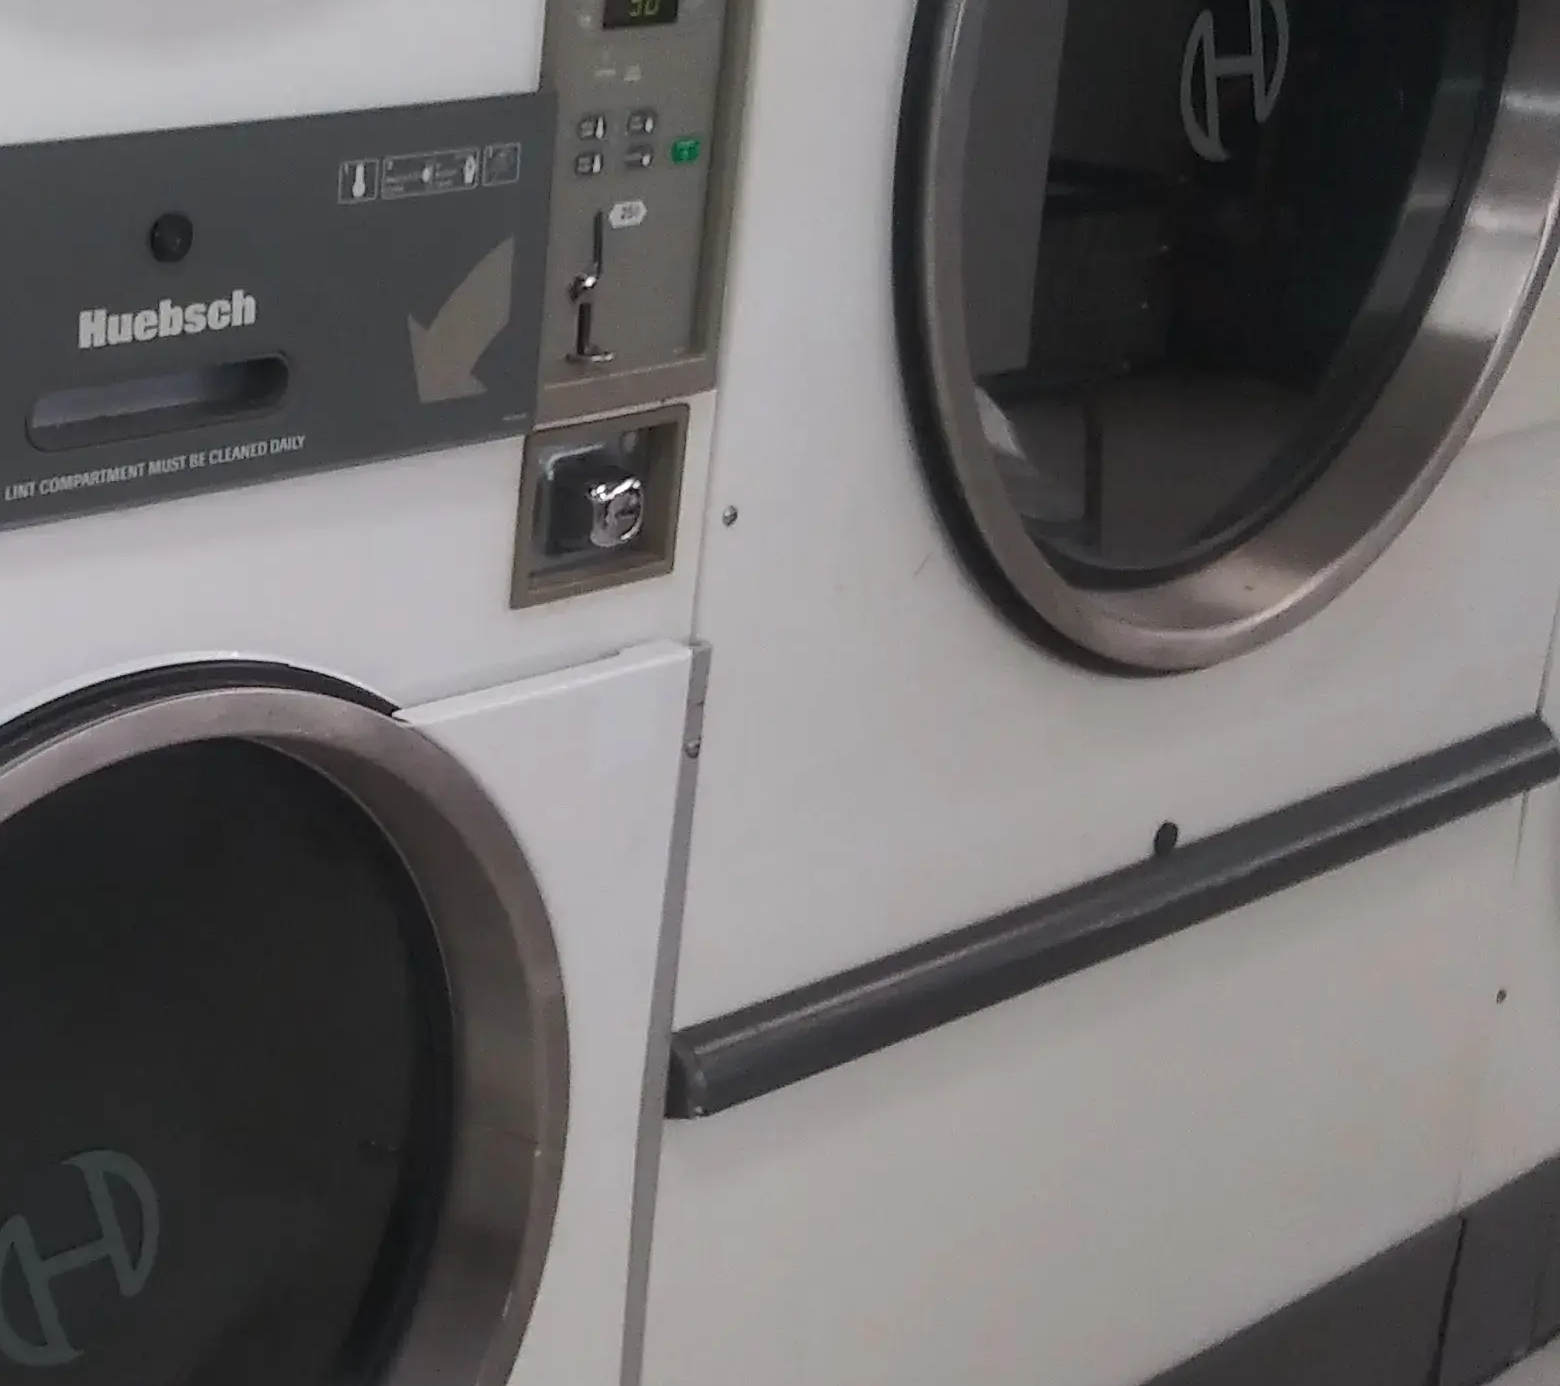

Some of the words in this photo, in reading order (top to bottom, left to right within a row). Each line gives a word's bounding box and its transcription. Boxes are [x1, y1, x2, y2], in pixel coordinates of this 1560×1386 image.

[78, 288, 257, 349] Huebsch
[4, 481, 36, 501] LINT
[39, 461, 146, 495] COMPARTMENT
[148, 455, 187, 476] MUST
[189, 452, 206, 469] BE
[208, 441, 268, 465] CLEANED
[269, 435, 306, 454] DAILY
